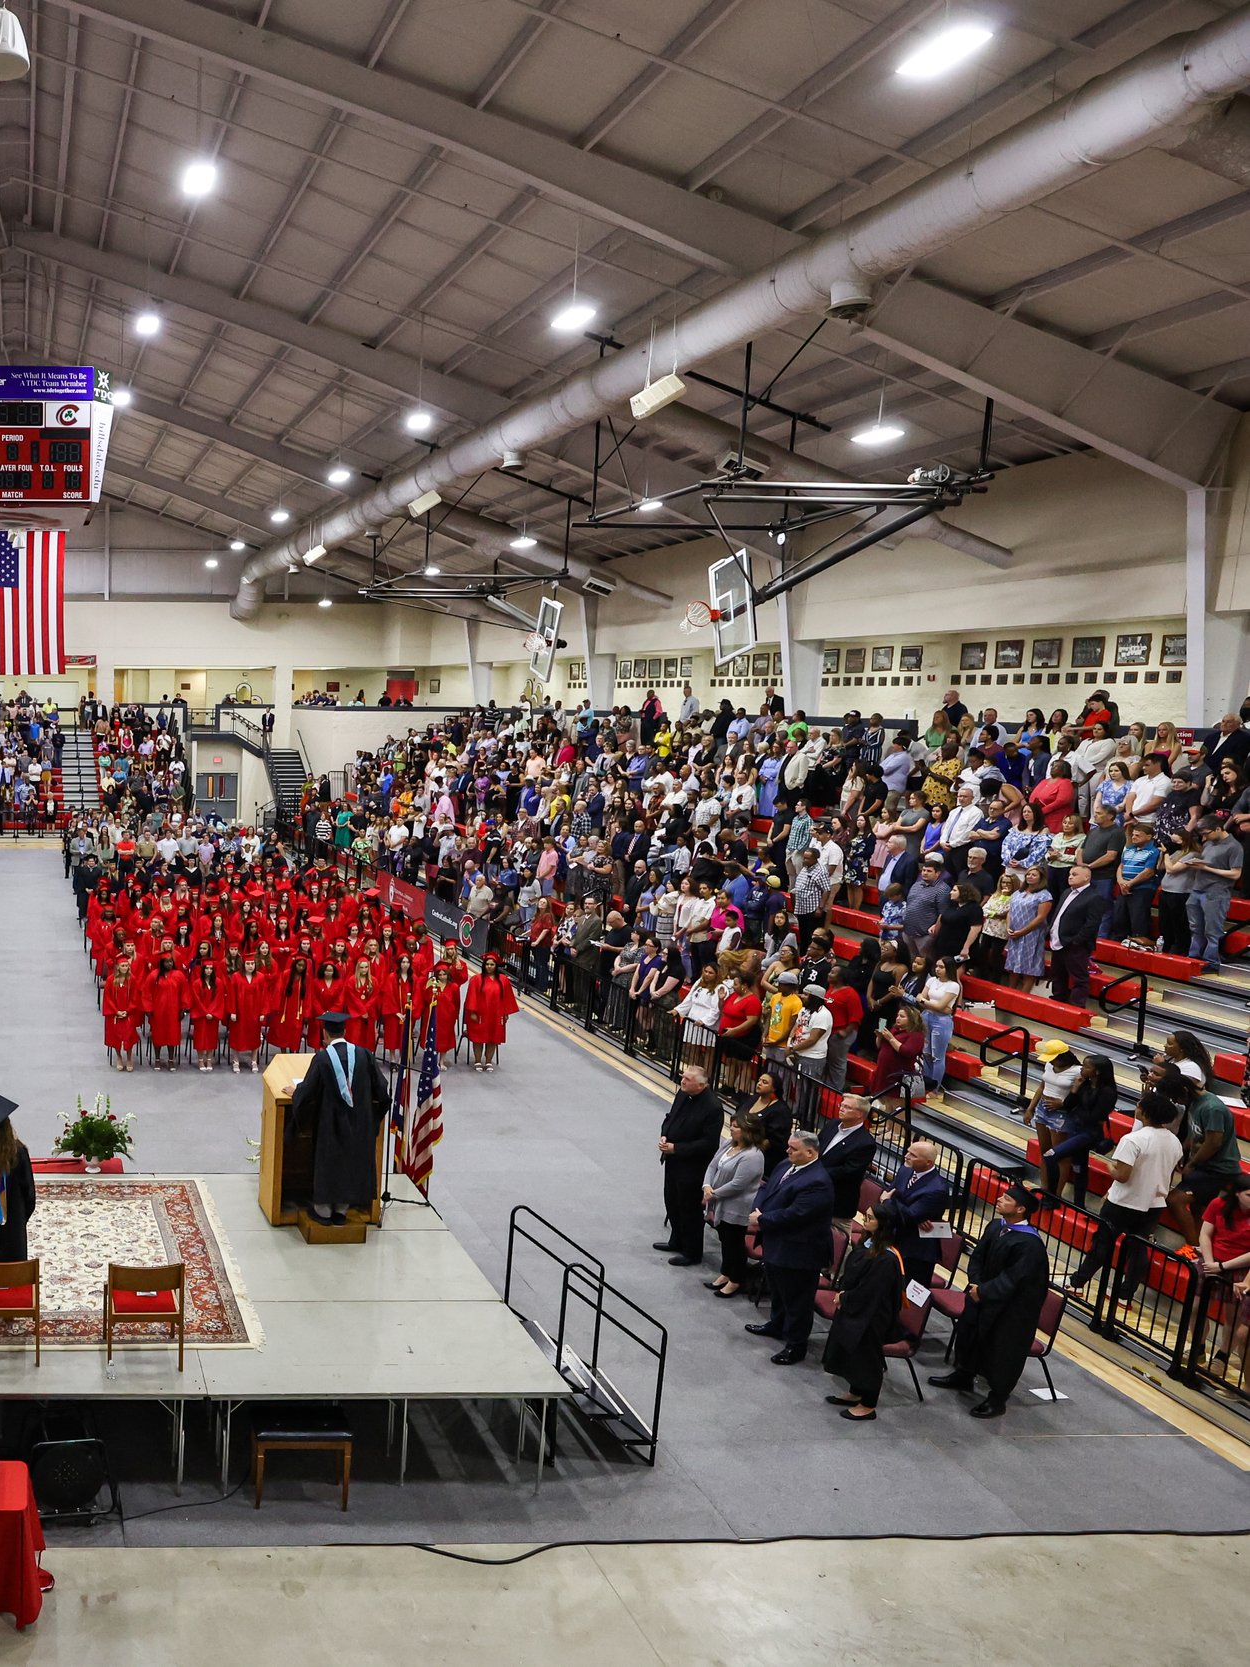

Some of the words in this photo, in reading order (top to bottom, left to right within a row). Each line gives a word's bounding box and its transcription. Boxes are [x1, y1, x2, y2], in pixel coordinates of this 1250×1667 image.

[94, 387, 114, 400] TDC
[1, 434, 24, 442] PERIOD
[18, 464, 34, 472] FOUL
[40, 464, 57, 472] T.O.L.
[63, 464, 83, 472] FOULS
[63, 491, 83, 499] SCORE
